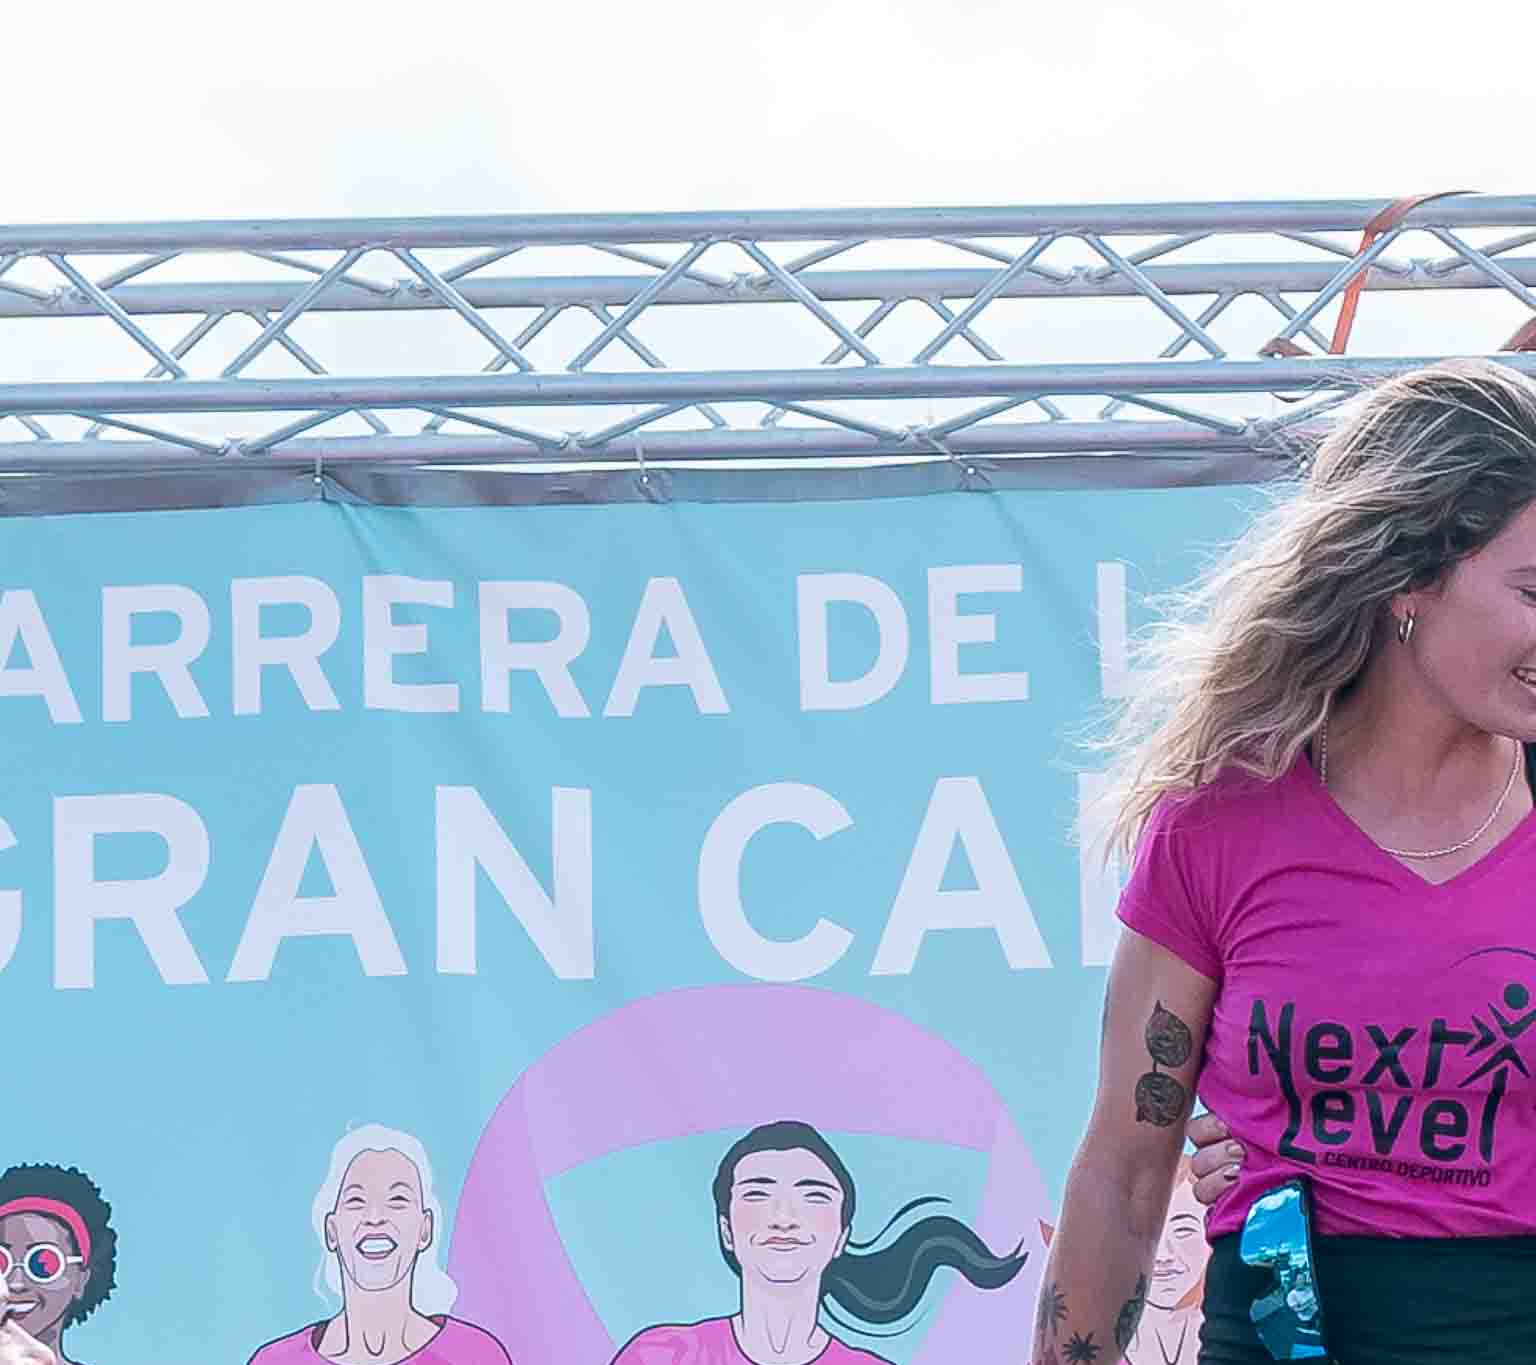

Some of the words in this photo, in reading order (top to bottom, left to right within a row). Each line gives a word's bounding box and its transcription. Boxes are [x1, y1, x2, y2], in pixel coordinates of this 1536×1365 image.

[795, 561, 1031, 714] DE
[1323, 1149, 1395, 1175] CENTRO
[1396, 1161, 1493, 1188] DEPORTIVO
